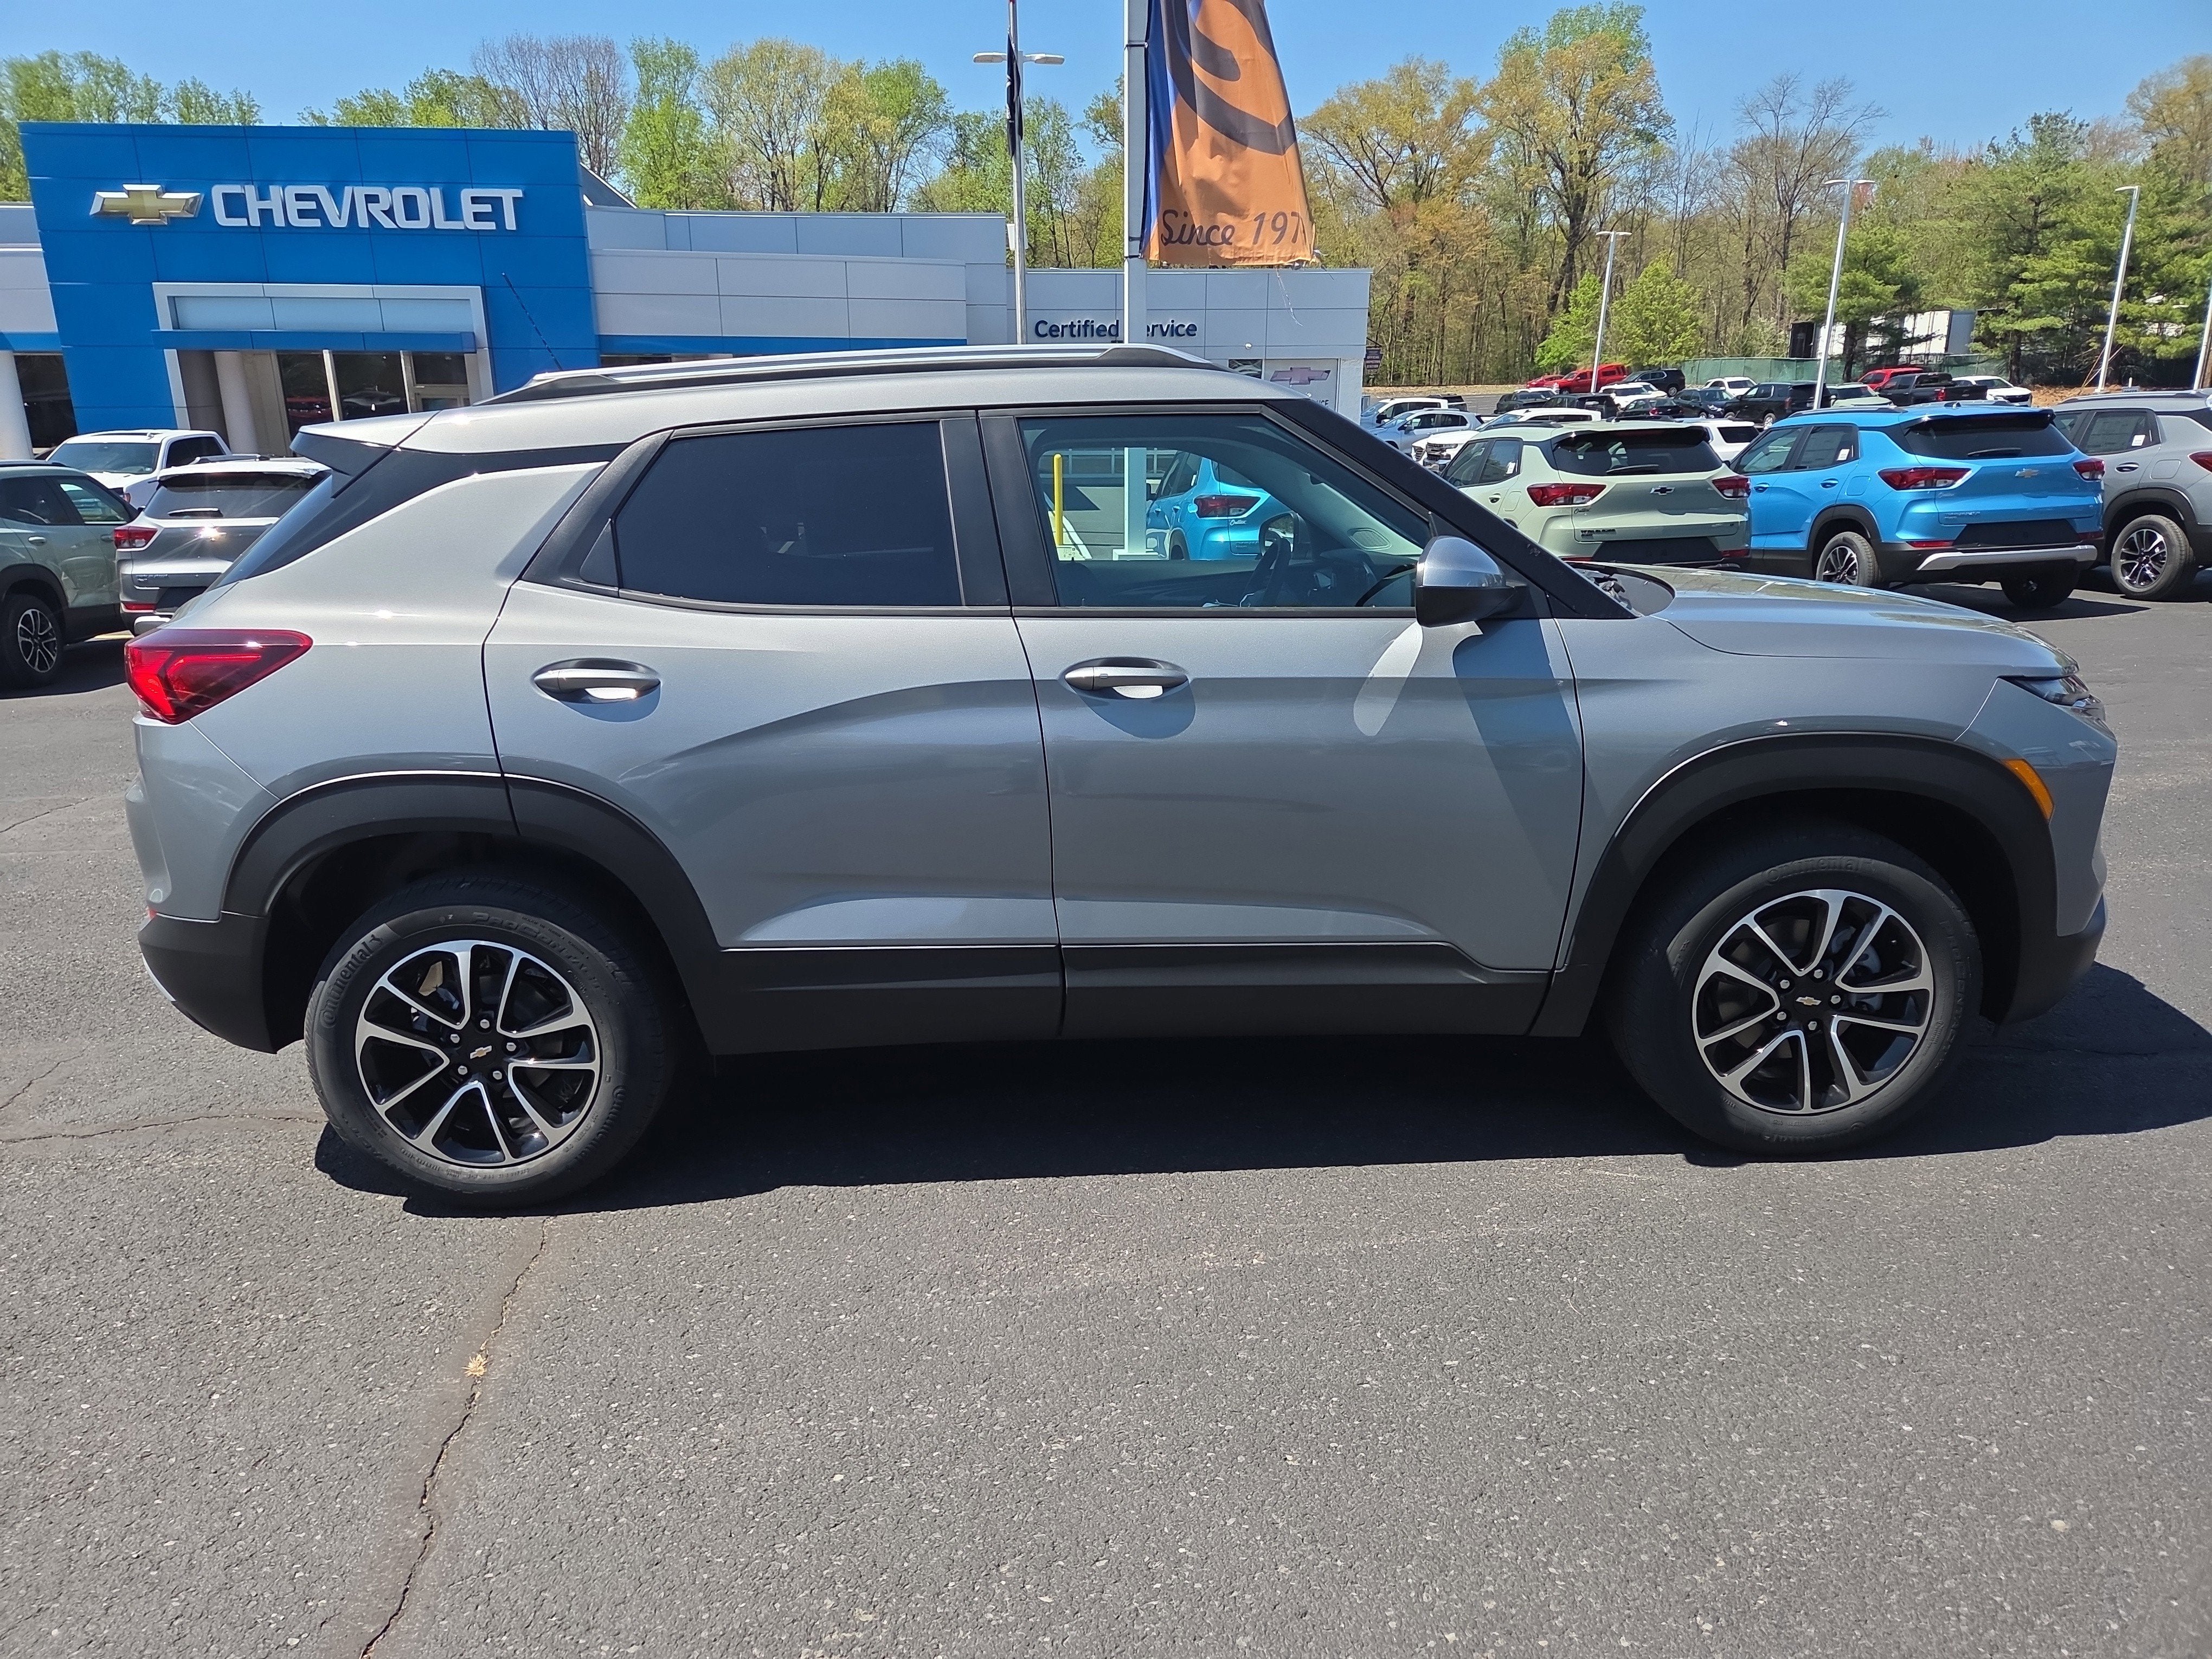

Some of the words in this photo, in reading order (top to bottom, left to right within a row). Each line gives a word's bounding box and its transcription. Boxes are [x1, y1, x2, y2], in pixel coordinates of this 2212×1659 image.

[211, 184, 524, 231] CHEVROLET
[1161, 209, 1235, 246] Since
[1034, 319, 1120, 338] Certified
[1147, 319, 1198, 337] rvice
[319, 941, 375, 1029] Continental
